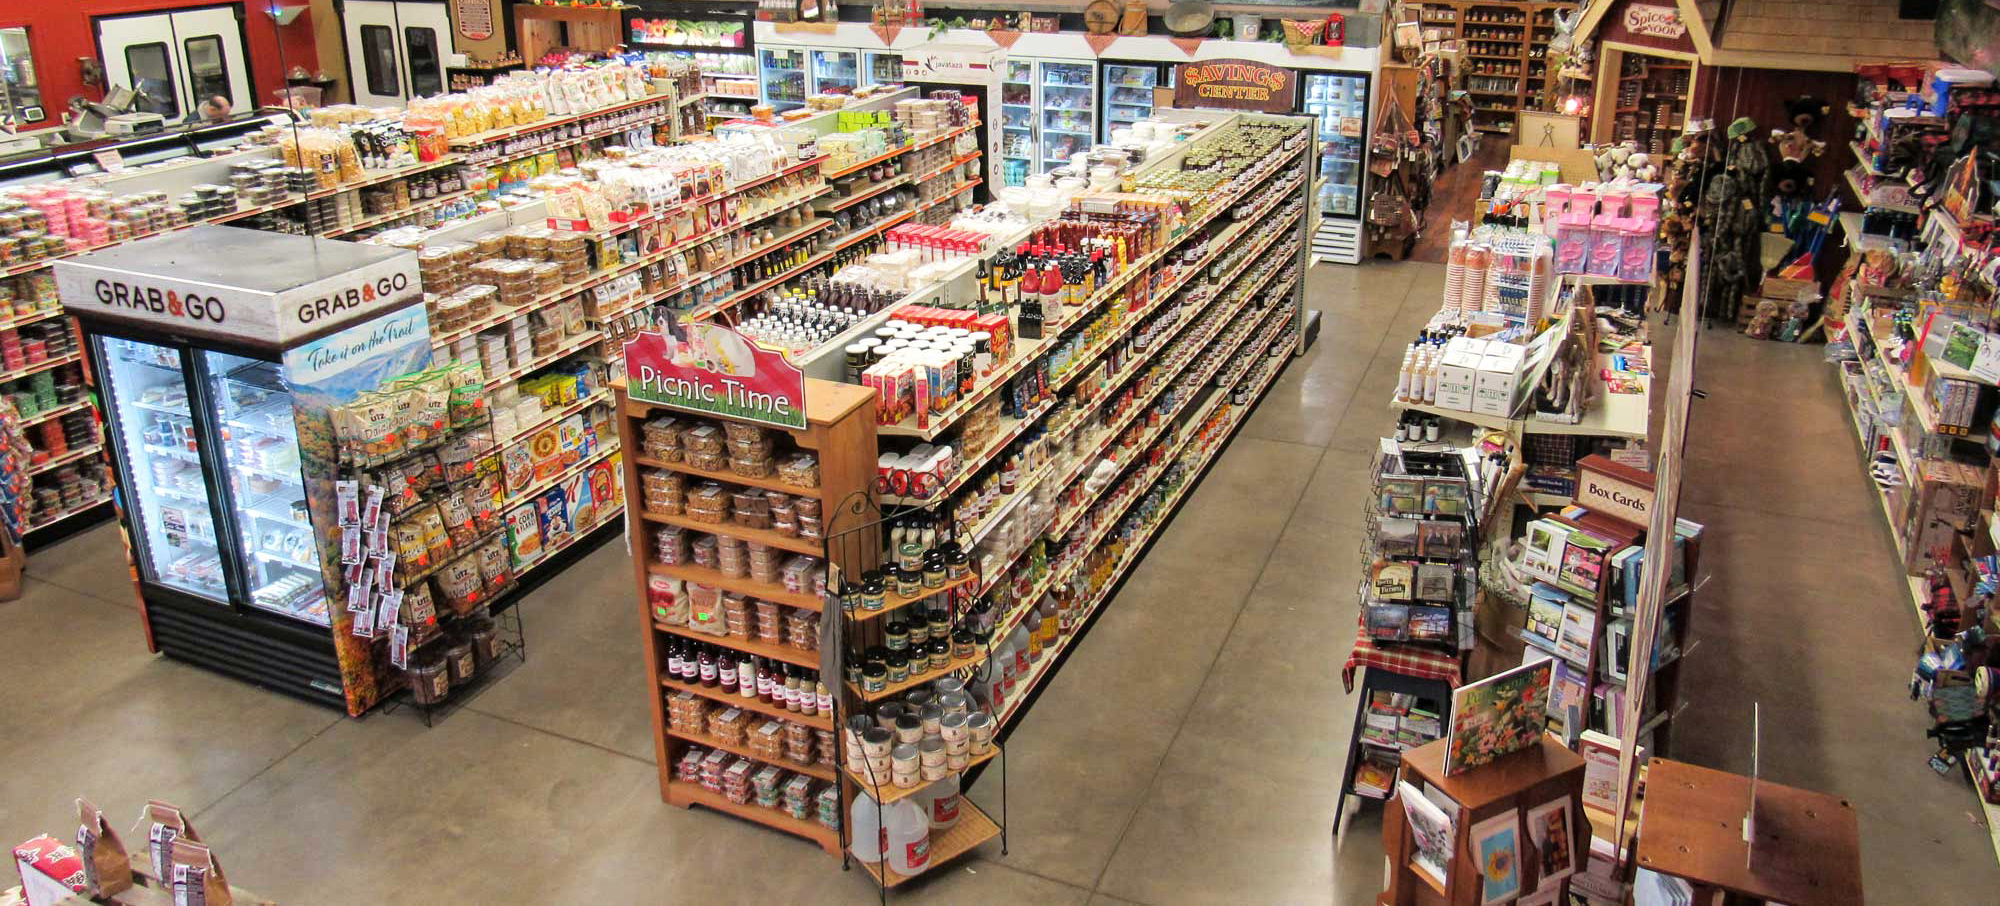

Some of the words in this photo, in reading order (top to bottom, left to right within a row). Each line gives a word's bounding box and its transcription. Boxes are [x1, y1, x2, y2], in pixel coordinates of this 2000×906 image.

[1628, 11, 1666, 26] Spice
[1198, 84, 1270, 101] CENTER
[95, 279, 225, 324] GRAB&GO
[298, 272, 408, 324] GRAB&GO
[308, 346, 337, 373] Take
[351, 341, 366, 356] on
[366, 329, 386, 351] the
[383, 316, 415, 344] Trail
[640, 365, 715, 403] Picnic
[720, 378, 790, 416] Time
[1588, 483, 1610, 499] Box
[1612, 492, 1646, 512] Cards
[518, 511, 535, 525] CORN
